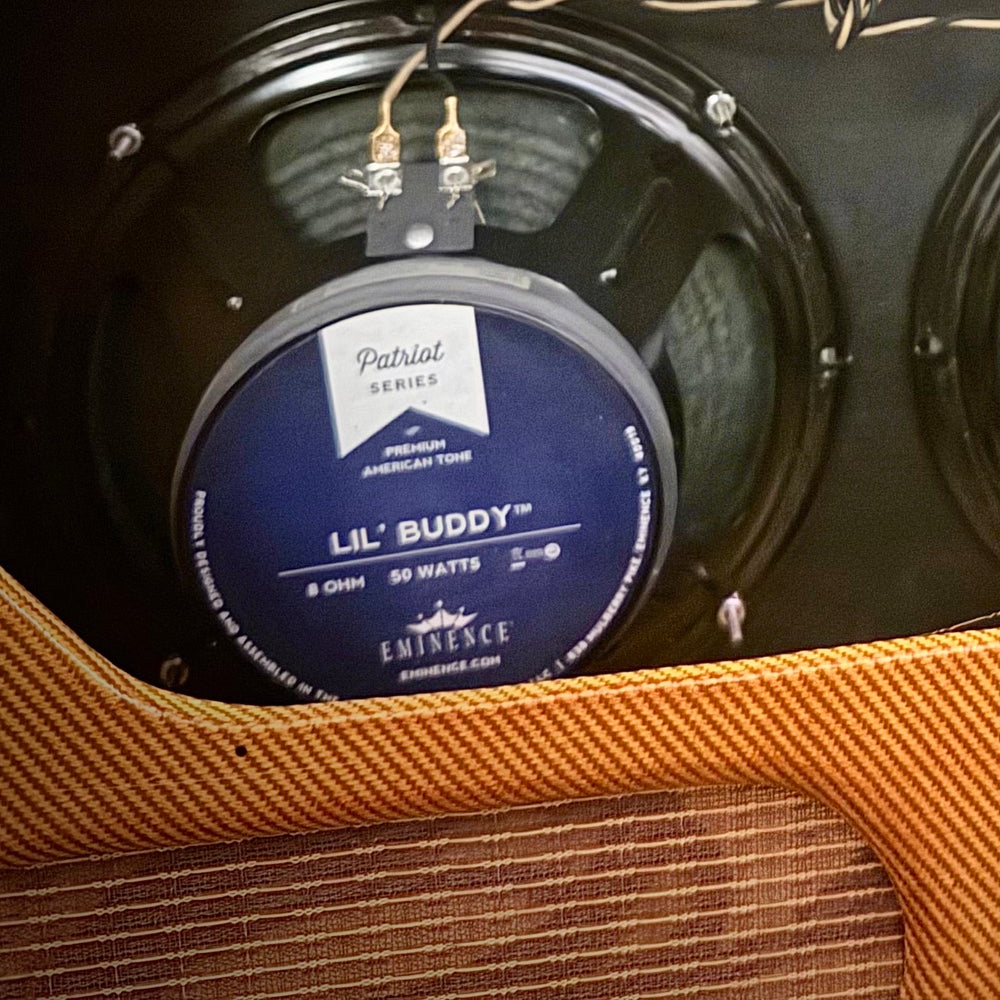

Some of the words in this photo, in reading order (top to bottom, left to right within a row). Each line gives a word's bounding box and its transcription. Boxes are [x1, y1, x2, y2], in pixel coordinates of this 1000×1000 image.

[356, 340, 445, 376] Patriot
[370, 373, 439, 394] SERIES
[361, 456, 433, 479] AMERICAN
[436, 449, 473, 466] TONE
[384, 438, 446, 459] PREMIUM
[193, 490, 207, 548] PROUDLY
[328, 522, 386, 557] LIL'
[194, 550, 225, 610] DESIGNED
[305, 582, 320, 599] 8
[322, 574, 366, 597] OHM
[388, 567, 413, 587] 50
[416, 555, 482, 580] WATTS
[218, 610, 241, 636] AND
[379, 620, 511, 667] EMINENCE
[236, 635, 298, 688] ASSEMBLED
[399, 654, 502, 683] EMINENCE.COM
[296, 681, 313, 696] IN
